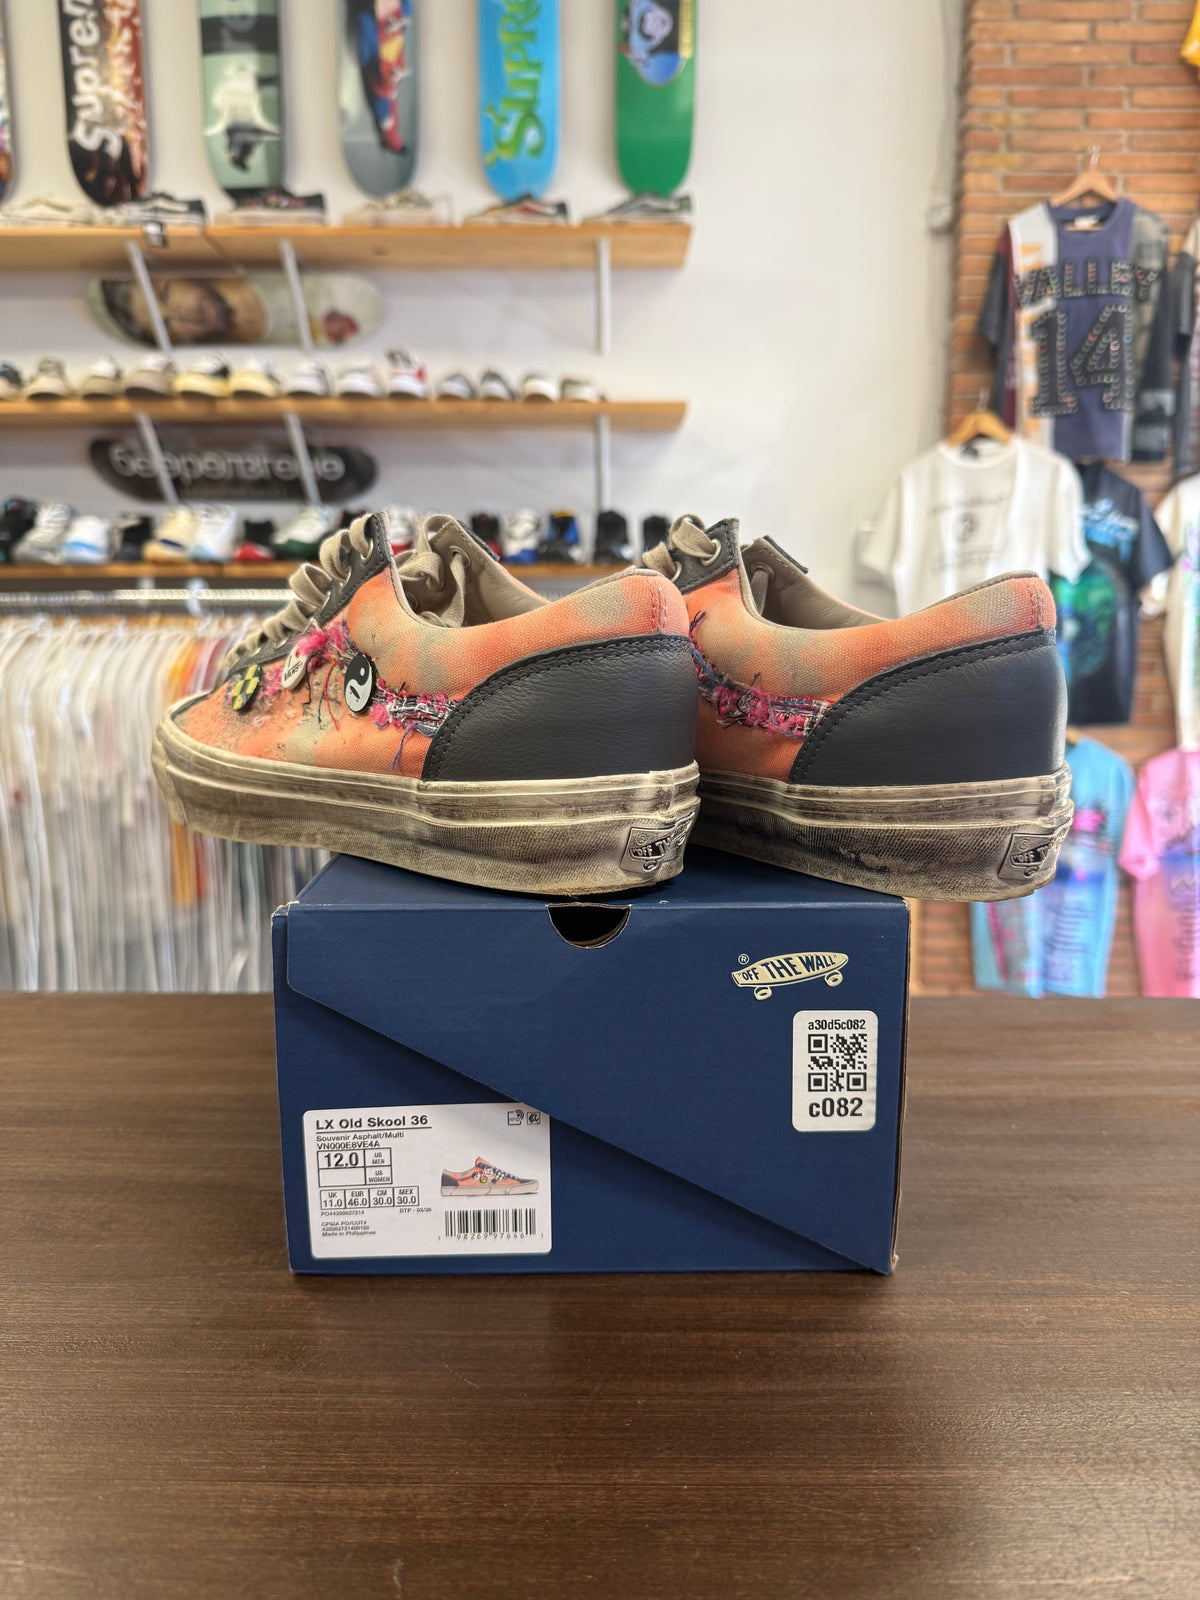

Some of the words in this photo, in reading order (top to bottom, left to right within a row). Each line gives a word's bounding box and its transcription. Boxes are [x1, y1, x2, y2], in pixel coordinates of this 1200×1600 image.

[1029, 303, 1136, 416] 14
[760, 955, 802, 980] THE
[807, 1018, 866, 1031] a30d5c082
[808, 1096, 864, 1118] c082
[315, 1119, 335, 1131] LX
[339, 1117, 363, 1129] Old
[367, 1115, 406, 1128] Skool
[410, 1114, 428, 1126] 36
[316, 1133, 351, 1142] Souvenir
[352, 1130, 405, 1141] Asphalt/Multi
[316, 1141, 381, 1150] VN000E8VE4A
[323, 1151, 359, 1168] 12.0
[322, 1198, 343, 1208] 11.0
[347, 1197, 368, 1207] 46.0
[372, 1196, 393, 1206] 30.0
[396, 1195, 417, 1205] 30.0
